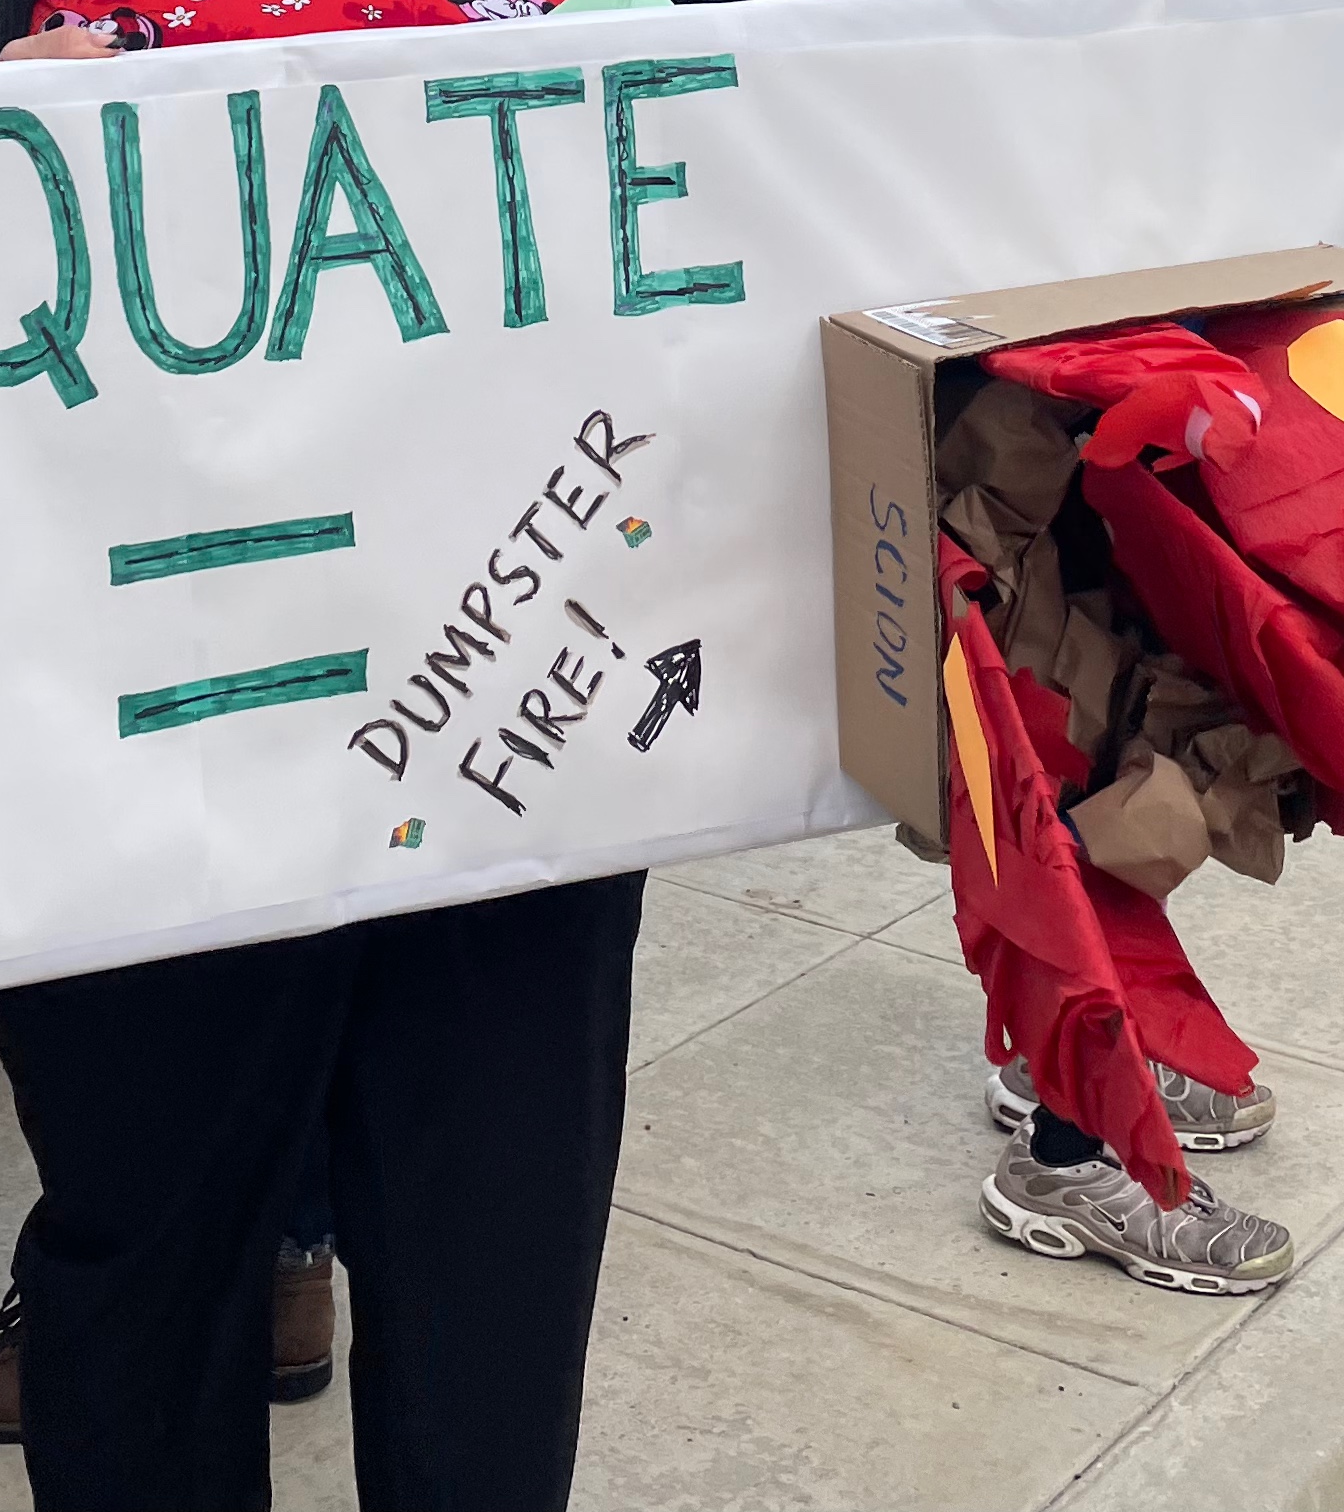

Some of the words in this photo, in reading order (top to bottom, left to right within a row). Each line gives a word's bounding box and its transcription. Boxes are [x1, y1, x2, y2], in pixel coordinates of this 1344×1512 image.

[348, 409, 655, 781] DUMPSTER
[869, 482, 908, 706] SCION
[458, 597, 626, 817] FIRE!
